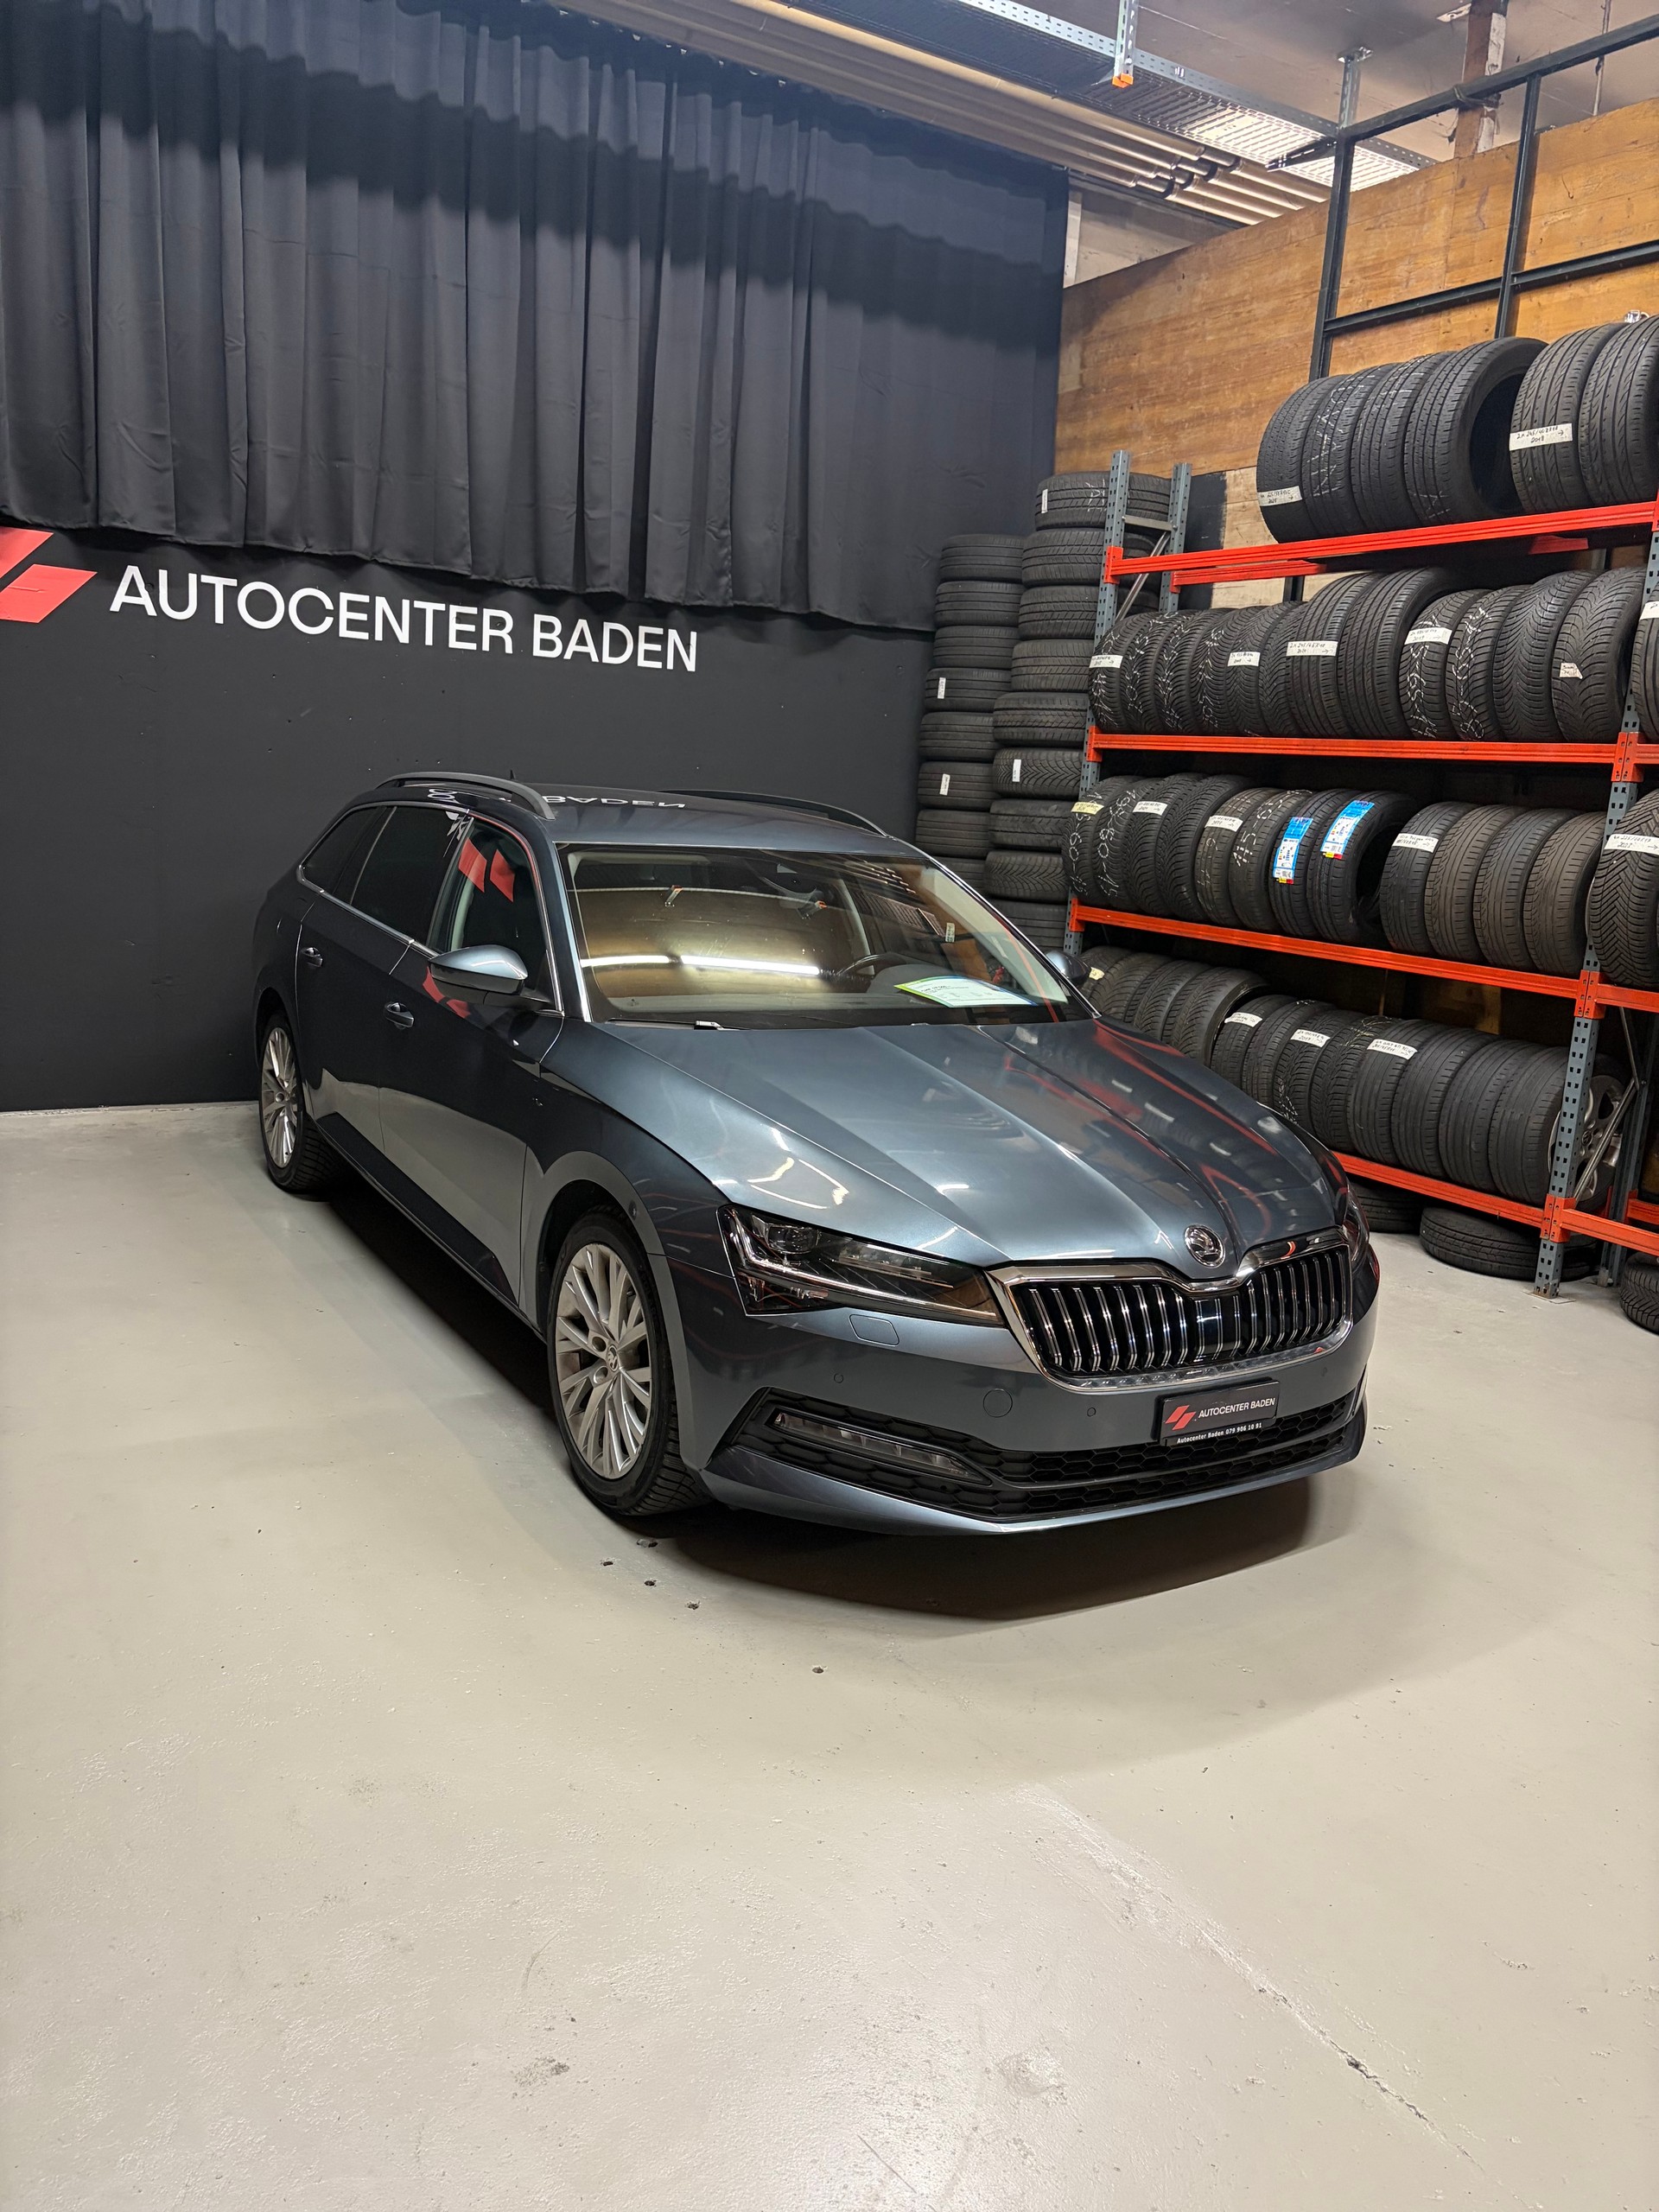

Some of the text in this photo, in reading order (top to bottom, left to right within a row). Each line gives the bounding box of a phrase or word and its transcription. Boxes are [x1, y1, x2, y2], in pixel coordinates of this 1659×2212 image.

[110, 565, 697, 672] AUTOCENTER BADEN
[1198, 1398, 1275, 1419] AUTOCENTER BADEN
[1177, 1433, 1206, 1444] Autocenter
[1208, 1430, 1224, 1439] Baden
